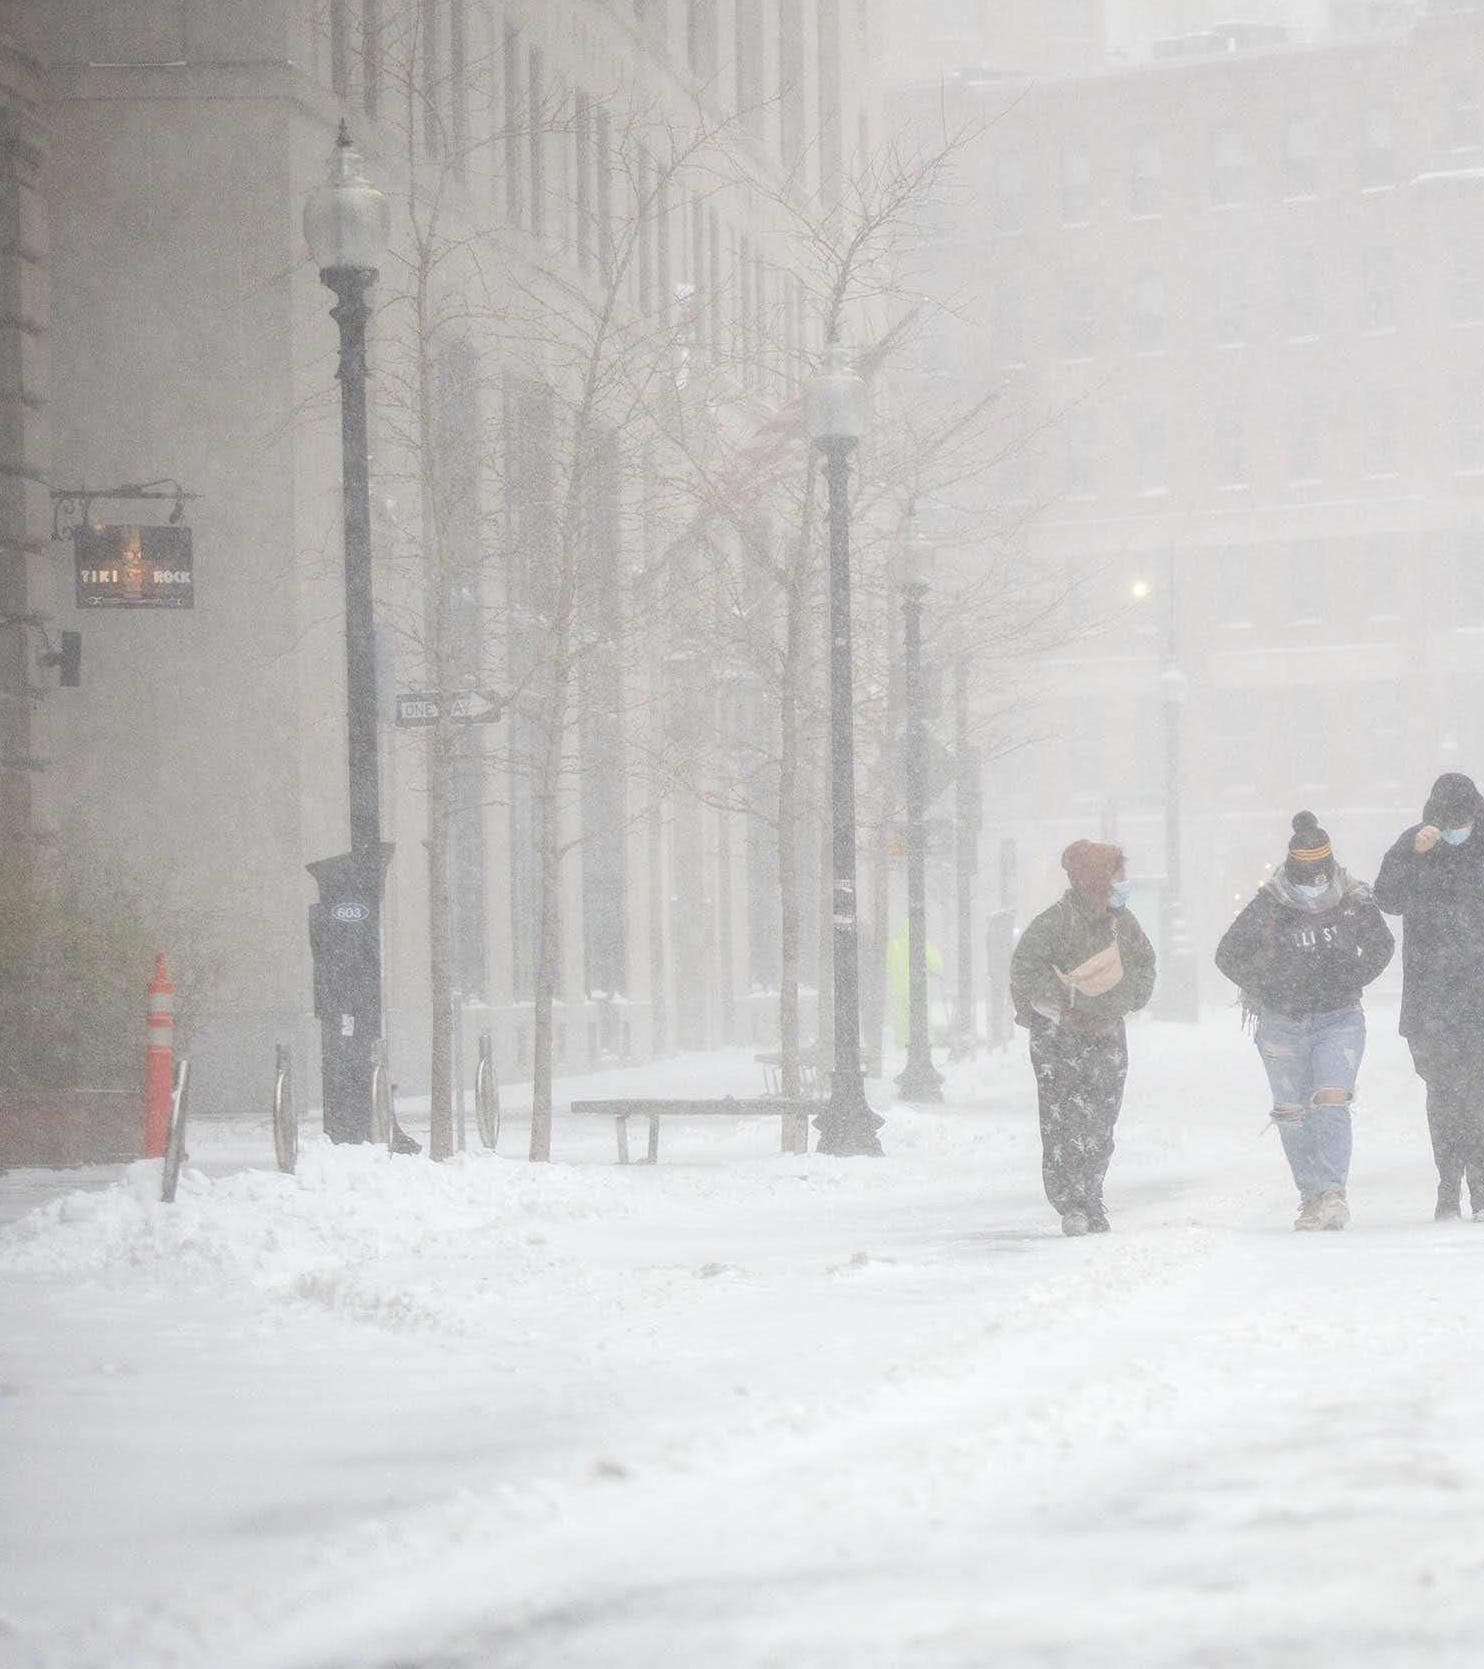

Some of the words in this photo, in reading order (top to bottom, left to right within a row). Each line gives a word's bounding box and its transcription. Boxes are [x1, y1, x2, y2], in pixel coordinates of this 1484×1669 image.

[80, 569, 118, 583] TIKI
[153, 569, 191, 584] ROCK
[405, 703, 433, 718] ONE
